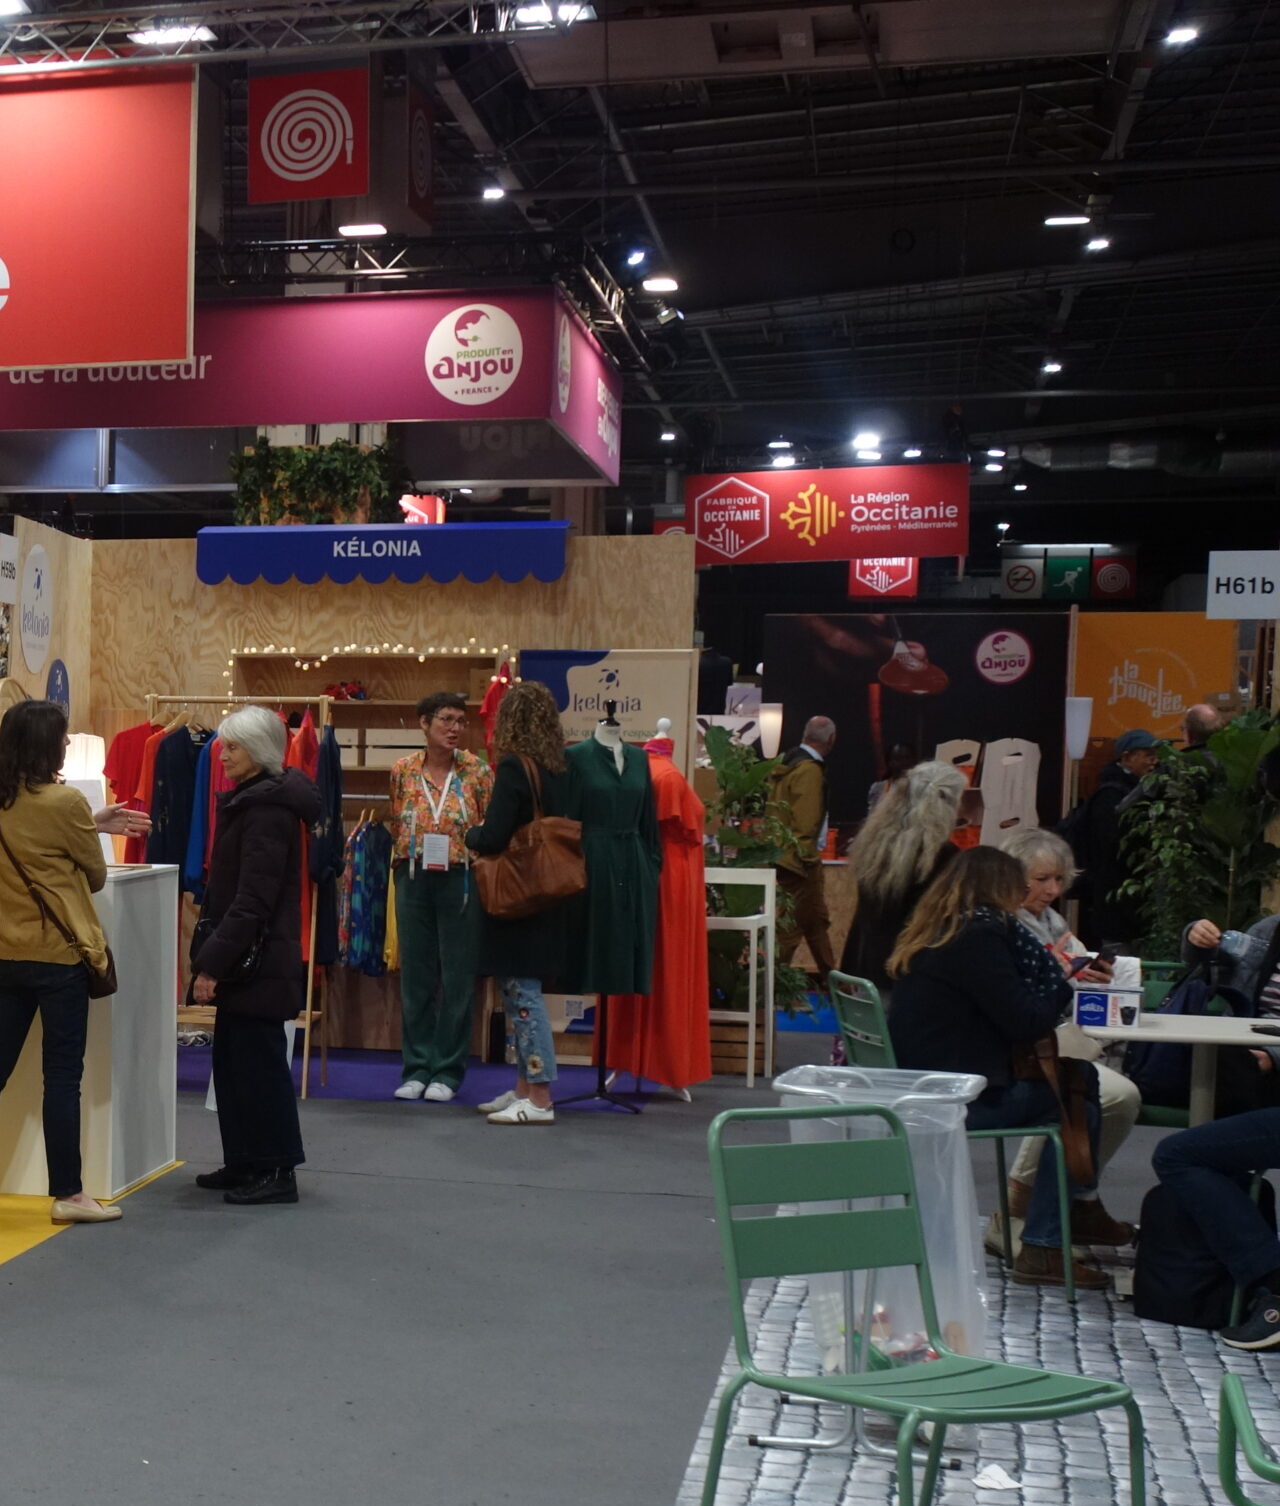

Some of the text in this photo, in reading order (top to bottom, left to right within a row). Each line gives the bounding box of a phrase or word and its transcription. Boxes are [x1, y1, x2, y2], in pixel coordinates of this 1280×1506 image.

[456, 347, 514, 360] PRODUIT en
[461, 386, 493, 395] FRANCE
[706, 495, 758, 506] FABRIQUÉ
[851, 491, 909, 504] La Région
[703, 508, 761, 523] OCCITANIE
[851, 501, 959, 522] Occitanie
[851, 523, 892, 532] Pyrénées
[898, 520, 959, 530] Méditerranée
[332, 536, 422, 558] KÉLONIA
[1215, 576, 1275, 595] H61b
